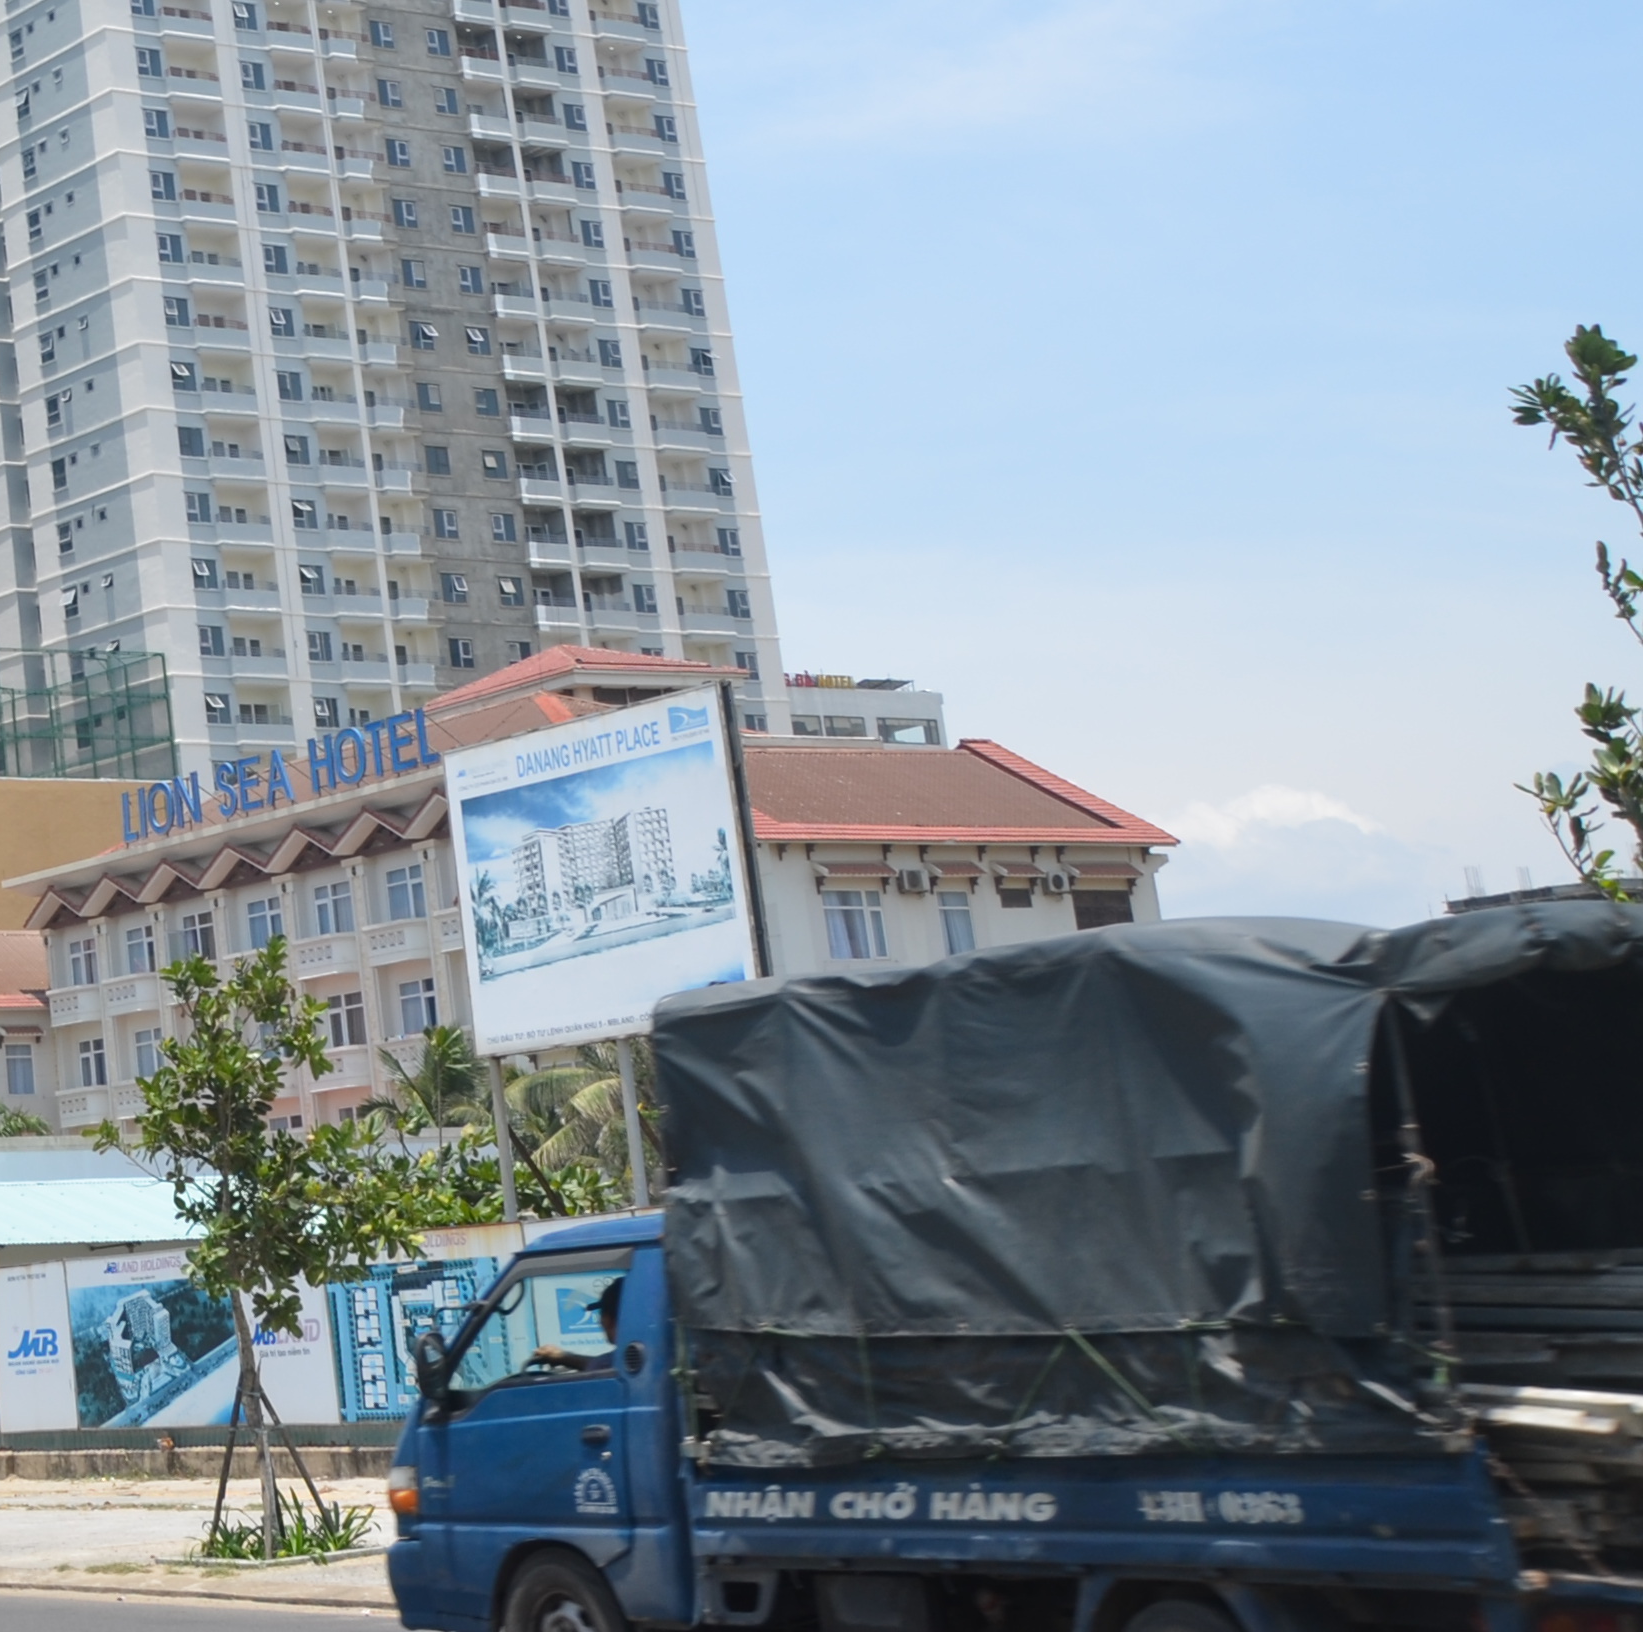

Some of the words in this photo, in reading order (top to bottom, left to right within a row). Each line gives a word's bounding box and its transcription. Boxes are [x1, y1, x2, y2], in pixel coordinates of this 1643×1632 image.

[516, 744, 571, 778] DANANG
[573, 733, 612, 765] HYATT
[616, 721, 660, 754] PLACE
[122, 771, 202, 842] LION
[217, 749, 294, 818] SEA
[307, 708, 440, 793] HOTEL
[420, 1232, 467, 1248] OLDINGS
[7, 1328, 59, 1359] MB
[704, 1485, 815, 1523] NHẬN
